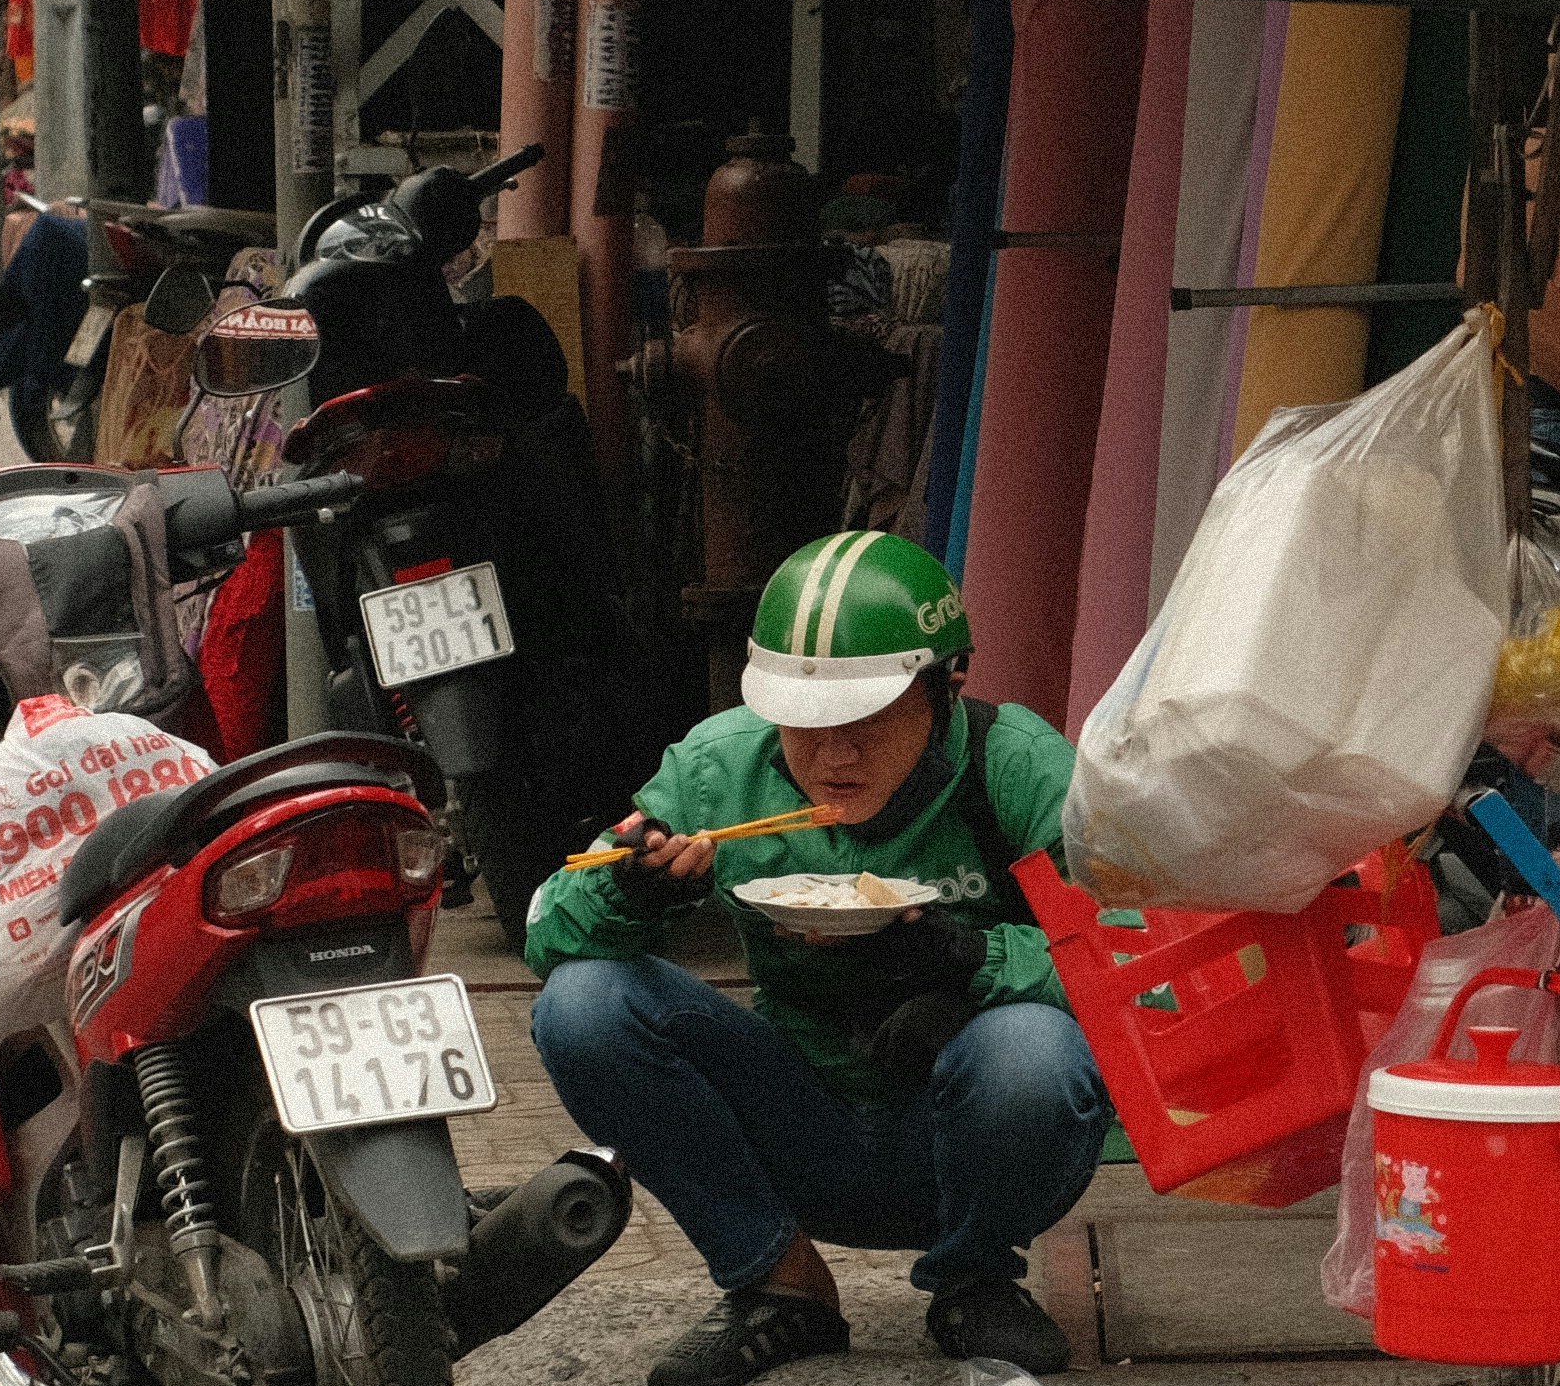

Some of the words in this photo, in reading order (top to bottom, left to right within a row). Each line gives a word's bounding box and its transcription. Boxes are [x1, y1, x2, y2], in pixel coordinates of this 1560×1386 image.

[382, 574, 483, 634] 59-L3
[386, 613, 501, 677] 430.11
[25, 759, 75, 798] Gọi
[79, 739, 128, 775] đặt
[127, 732, 172, 757] hàn
[309, 944, 376, 963] HONDA
[285, 989, 442, 1060] 59-G3
[293, 1047, 476, 1122] 141.76
